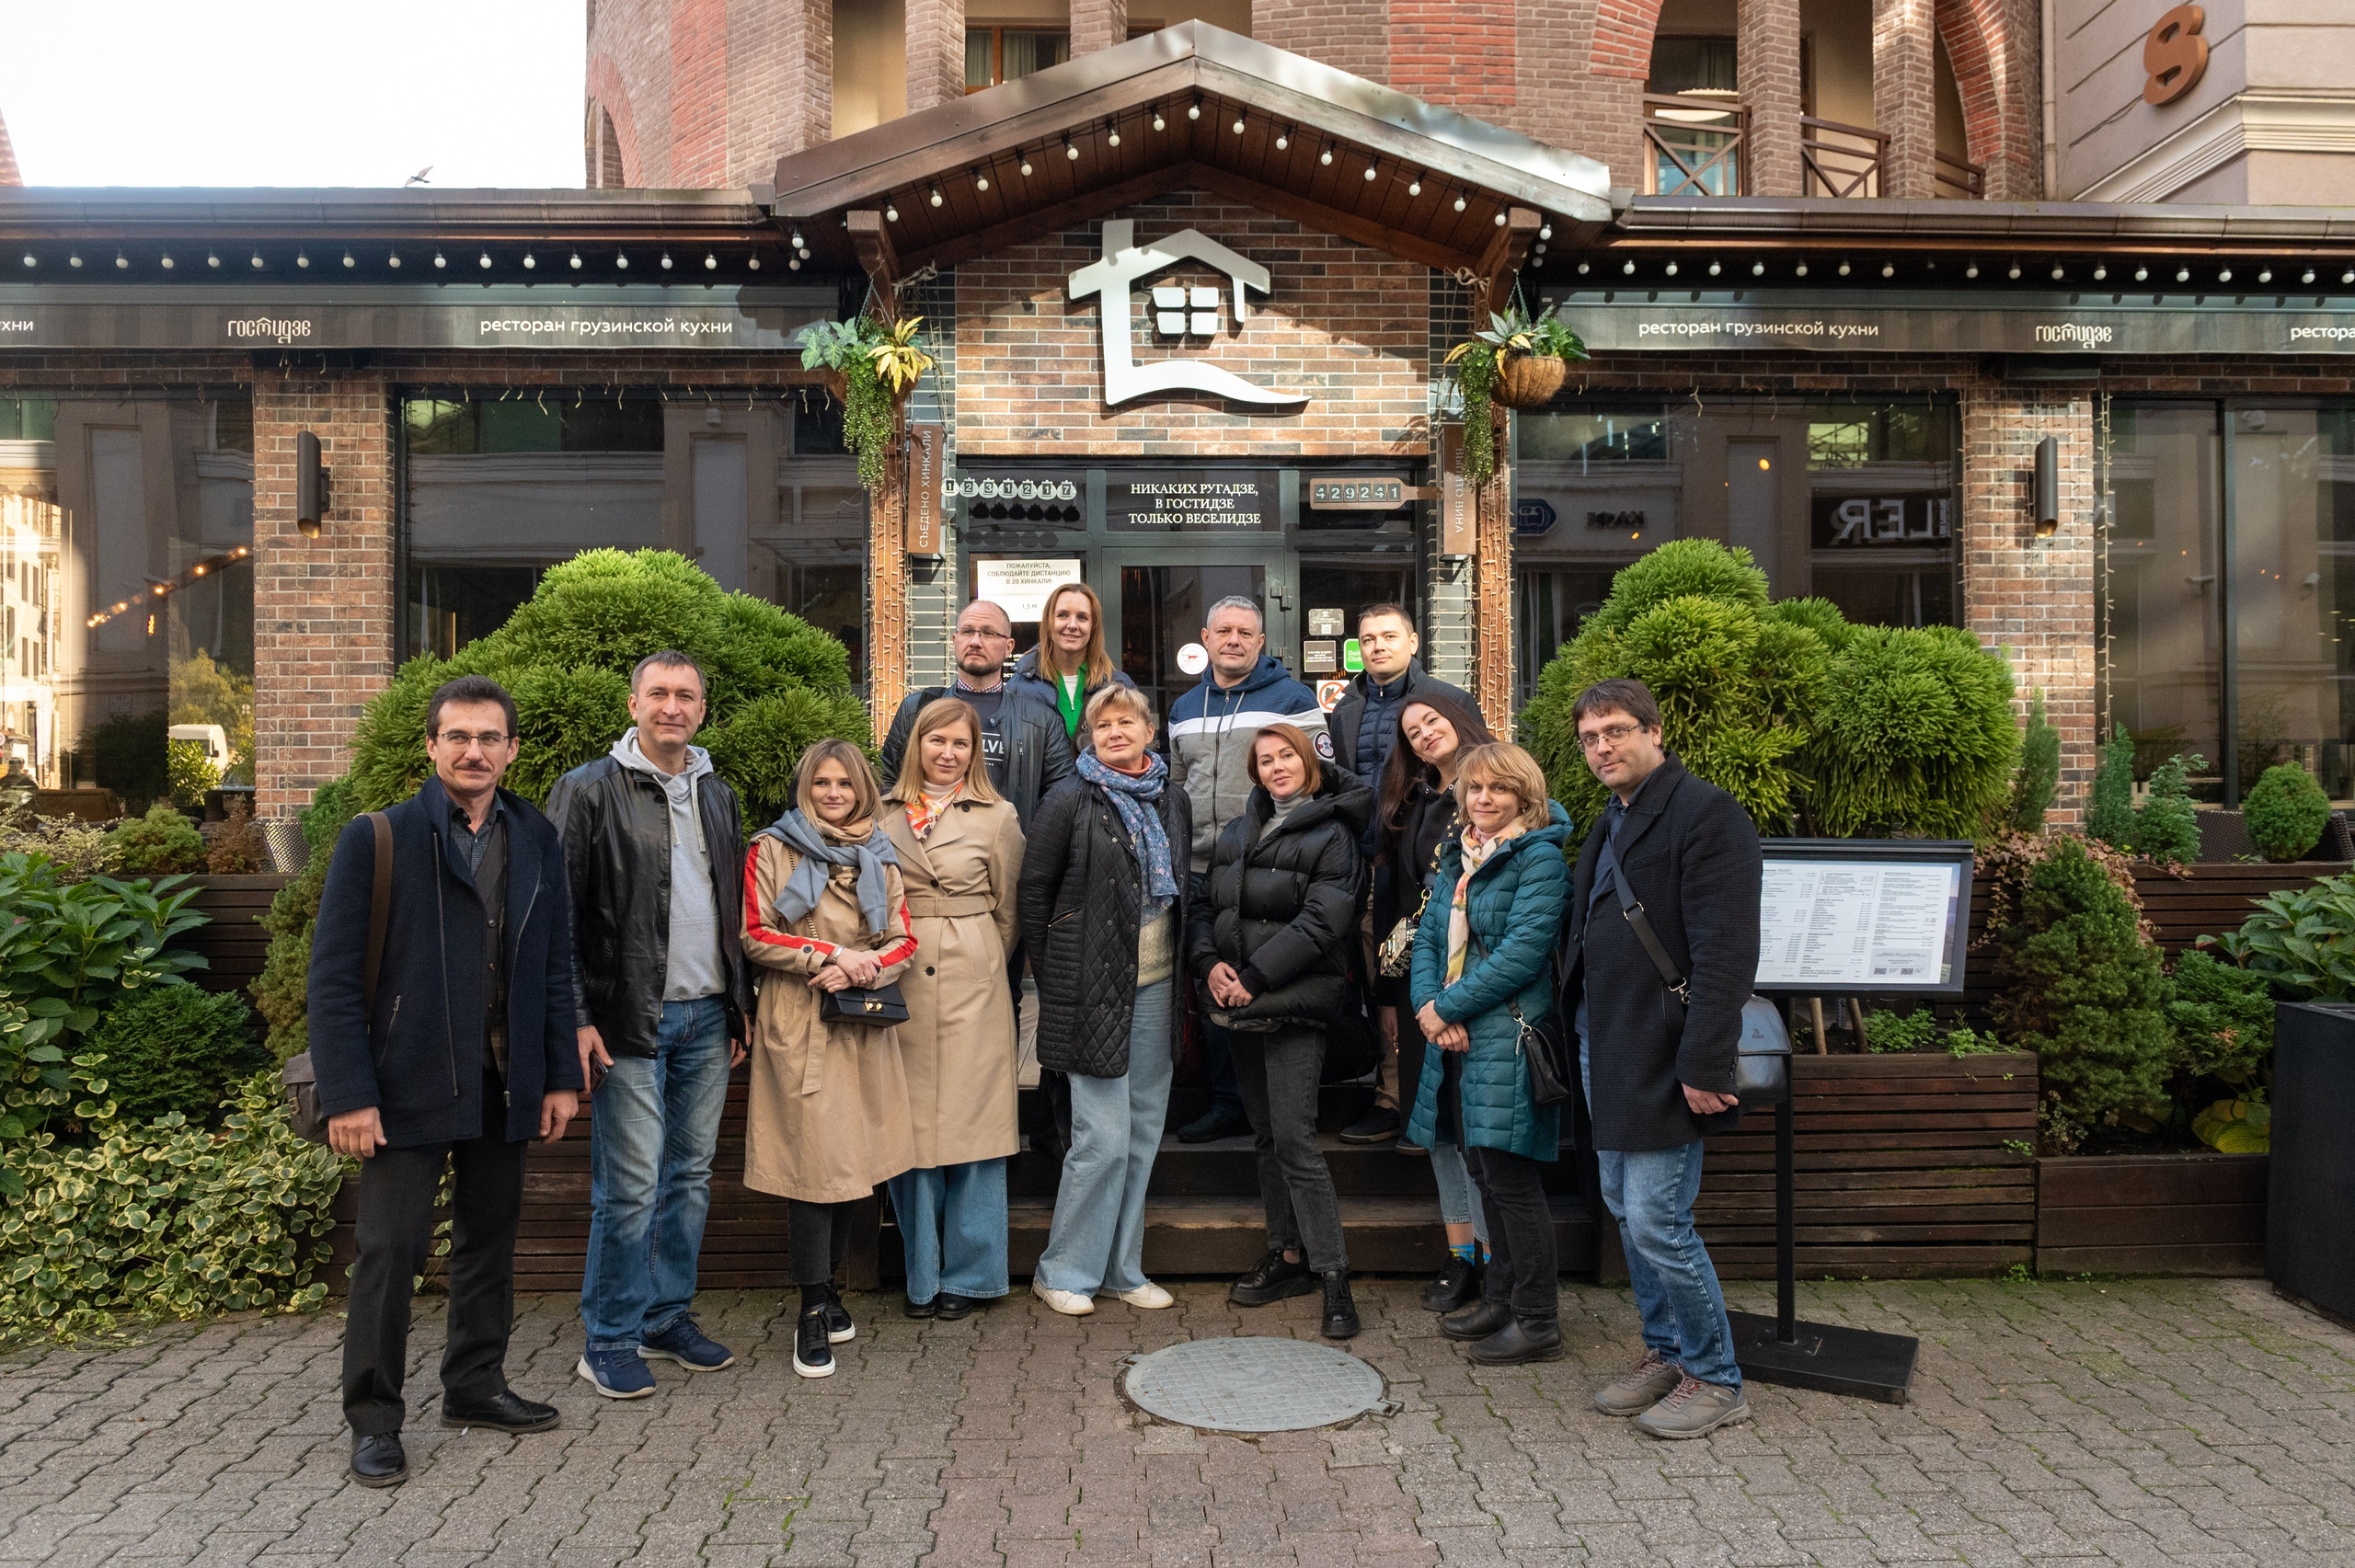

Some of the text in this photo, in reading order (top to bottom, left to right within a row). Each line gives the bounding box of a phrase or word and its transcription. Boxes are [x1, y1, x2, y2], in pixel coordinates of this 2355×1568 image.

[0, 320, 34, 331] хни
[480, 317, 733, 336] ресторан грузинской кухни
[1638, 321, 1878, 339] ресторан грузинской кухни
[919, 430, 932, 548] СЪЕДЕНО ХИНКАЛИ
[1131, 483, 1258, 497] НИКАКИХ РУГАДЗЕ,
[1454, 448, 1465, 533] ВЫПИТО ВИНА
[1155, 498, 1235, 511] В ГОСТИДЗЕ
[1128, 513, 1261, 526] ТОЛЬКО ВЕСЕЛИДЗЕ
